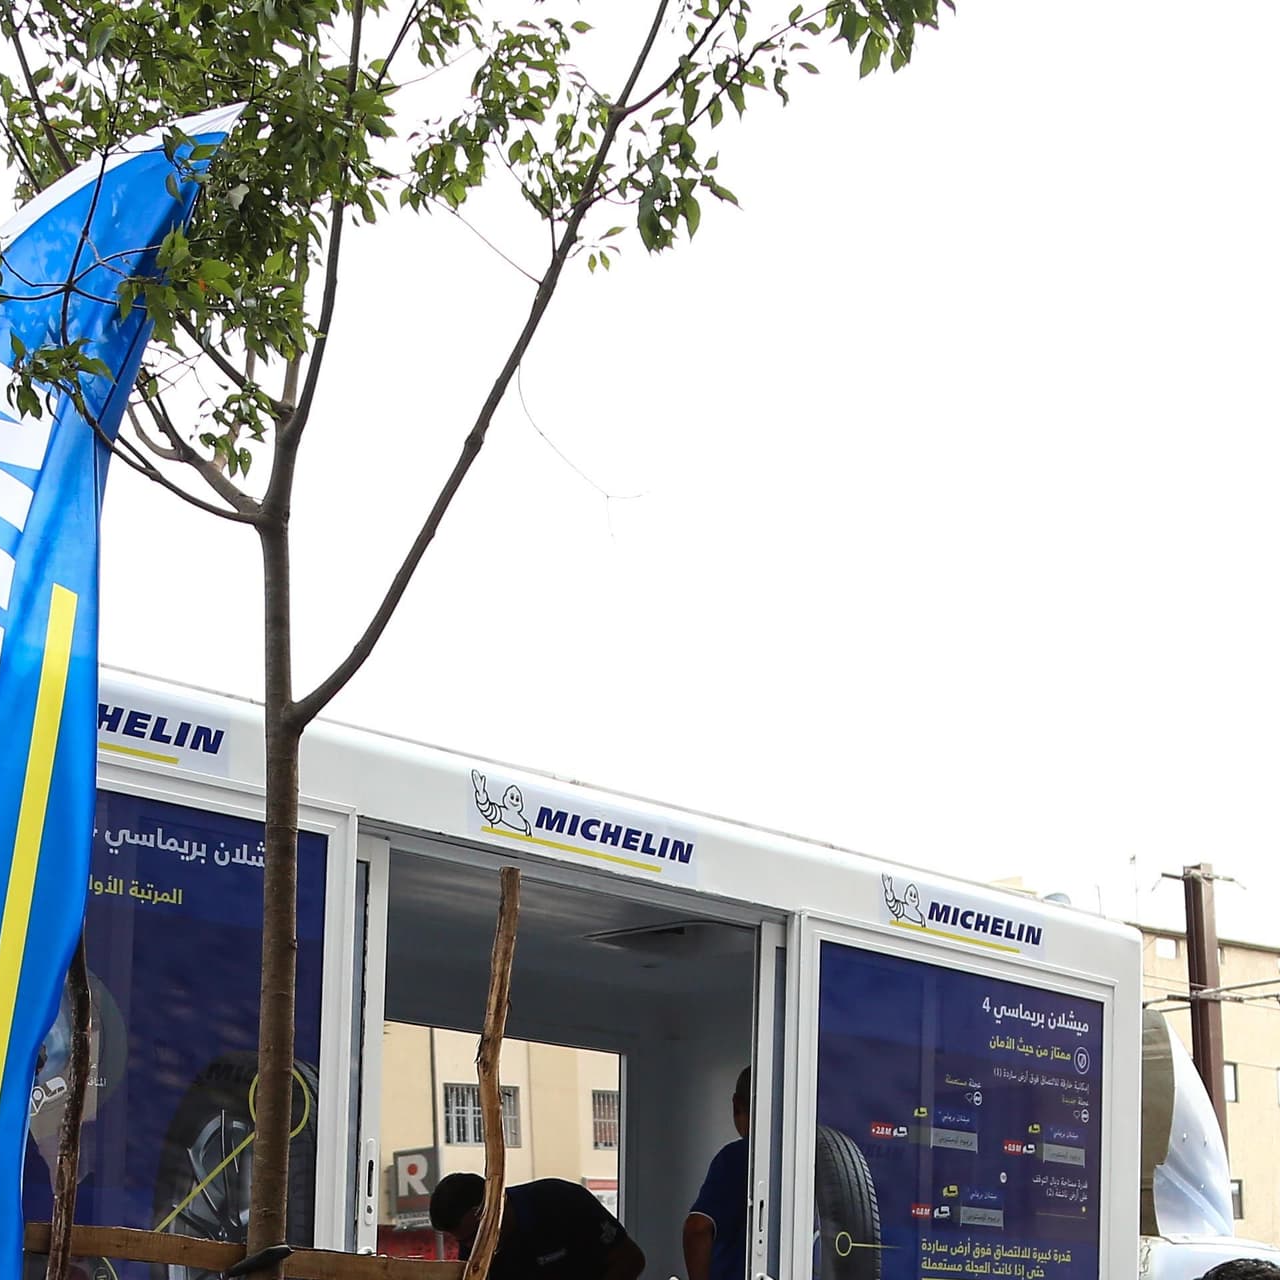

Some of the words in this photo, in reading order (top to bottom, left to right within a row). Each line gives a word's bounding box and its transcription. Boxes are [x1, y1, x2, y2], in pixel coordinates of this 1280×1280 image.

[97, 703, 224, 754] HELIN
[104, 826, 207, 864] بريماسي
[535, 806, 694, 864] MICHELIN
[129, 880, 183, 905] المرتبة
[927, 901, 1043, 946] MICHELIN
[982, 996, 991, 1013] 4
[993, 1003, 1044, 1029] بريماسي
[1048, 1010, 1089, 1036] ميشلان
[1036, 1046, 1048, 1058] من
[1051, 1046, 1072, 1060] ممتاز
[921, 1257, 962, 1272] مستعملة
